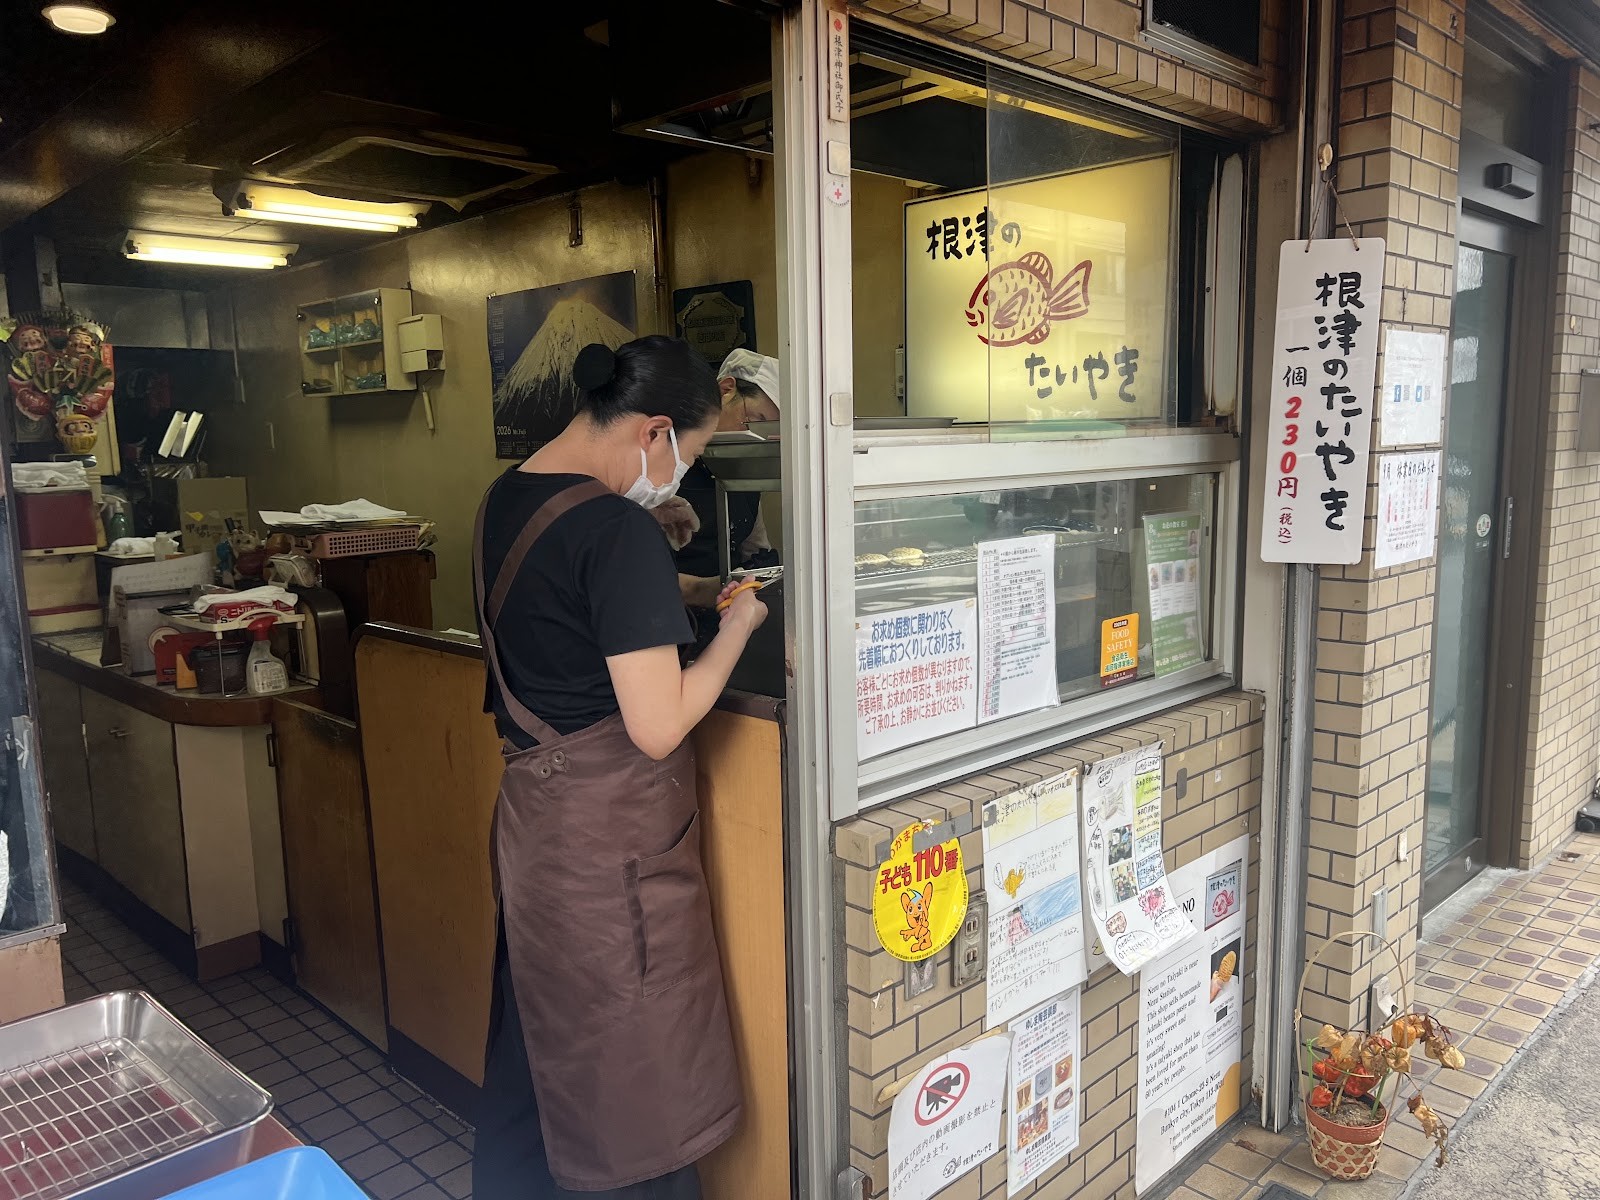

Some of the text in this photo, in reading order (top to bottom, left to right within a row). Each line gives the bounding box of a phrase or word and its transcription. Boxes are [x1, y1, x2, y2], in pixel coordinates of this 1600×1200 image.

[926, 206, 1022, 262] 根津の
[1024, 345, 1139, 403] たいやき
[1314, 271, 1365, 531] 根津のたいやき
[496, 425, 512, 436] 2026
[871, 608, 954, 644] お求め個数に関わりなく
[1112, 629, 1129, 640] FOOD
[858, 629, 966, 672] 先着順におつくりしております。
[1107, 638, 1132, 653] SAFETY
[856, 656, 973, 697] お客様ごとにお求め個数が異なりますので、
[880, 844, 958, 894] 子ども110番
[1167, 966, 1183, 983] Taiyaki
[1147, 1010, 1157, 1021] This
[1157, 1004, 1168, 1014] shop
[1155, 1031, 1164, 1042] very
[1165, 1022, 1178, 1034] sweet
[1178, 1014, 1187, 1026] and
[1173, 1042, 1184, 1054] shop
[1145, 1075, 1156, 1087] been
[1157, 1063, 1169, 1078] loved
[1152, 1082, 1164, 1097] years
[892, 1099, 996, 1182] 店頭及び店内の動画撮影を禁止と
